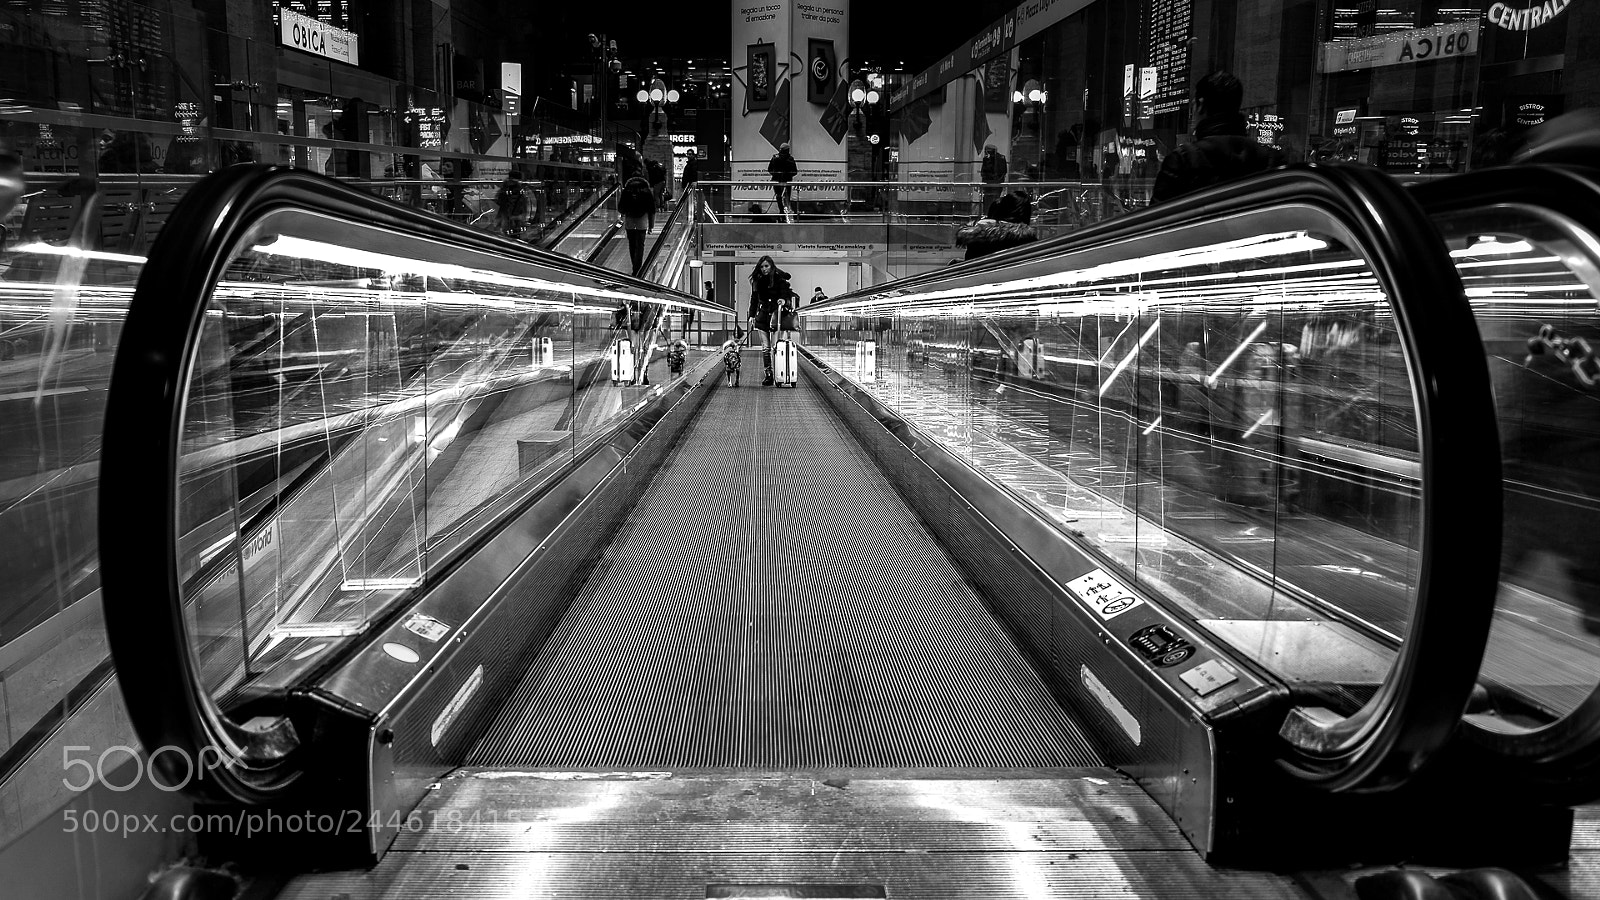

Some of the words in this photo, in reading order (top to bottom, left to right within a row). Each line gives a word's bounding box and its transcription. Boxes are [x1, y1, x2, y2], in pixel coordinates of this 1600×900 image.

[822, 8, 844, 16] personal
[751, 14, 776, 22] emozione
[456, 80, 475, 89] BAR
